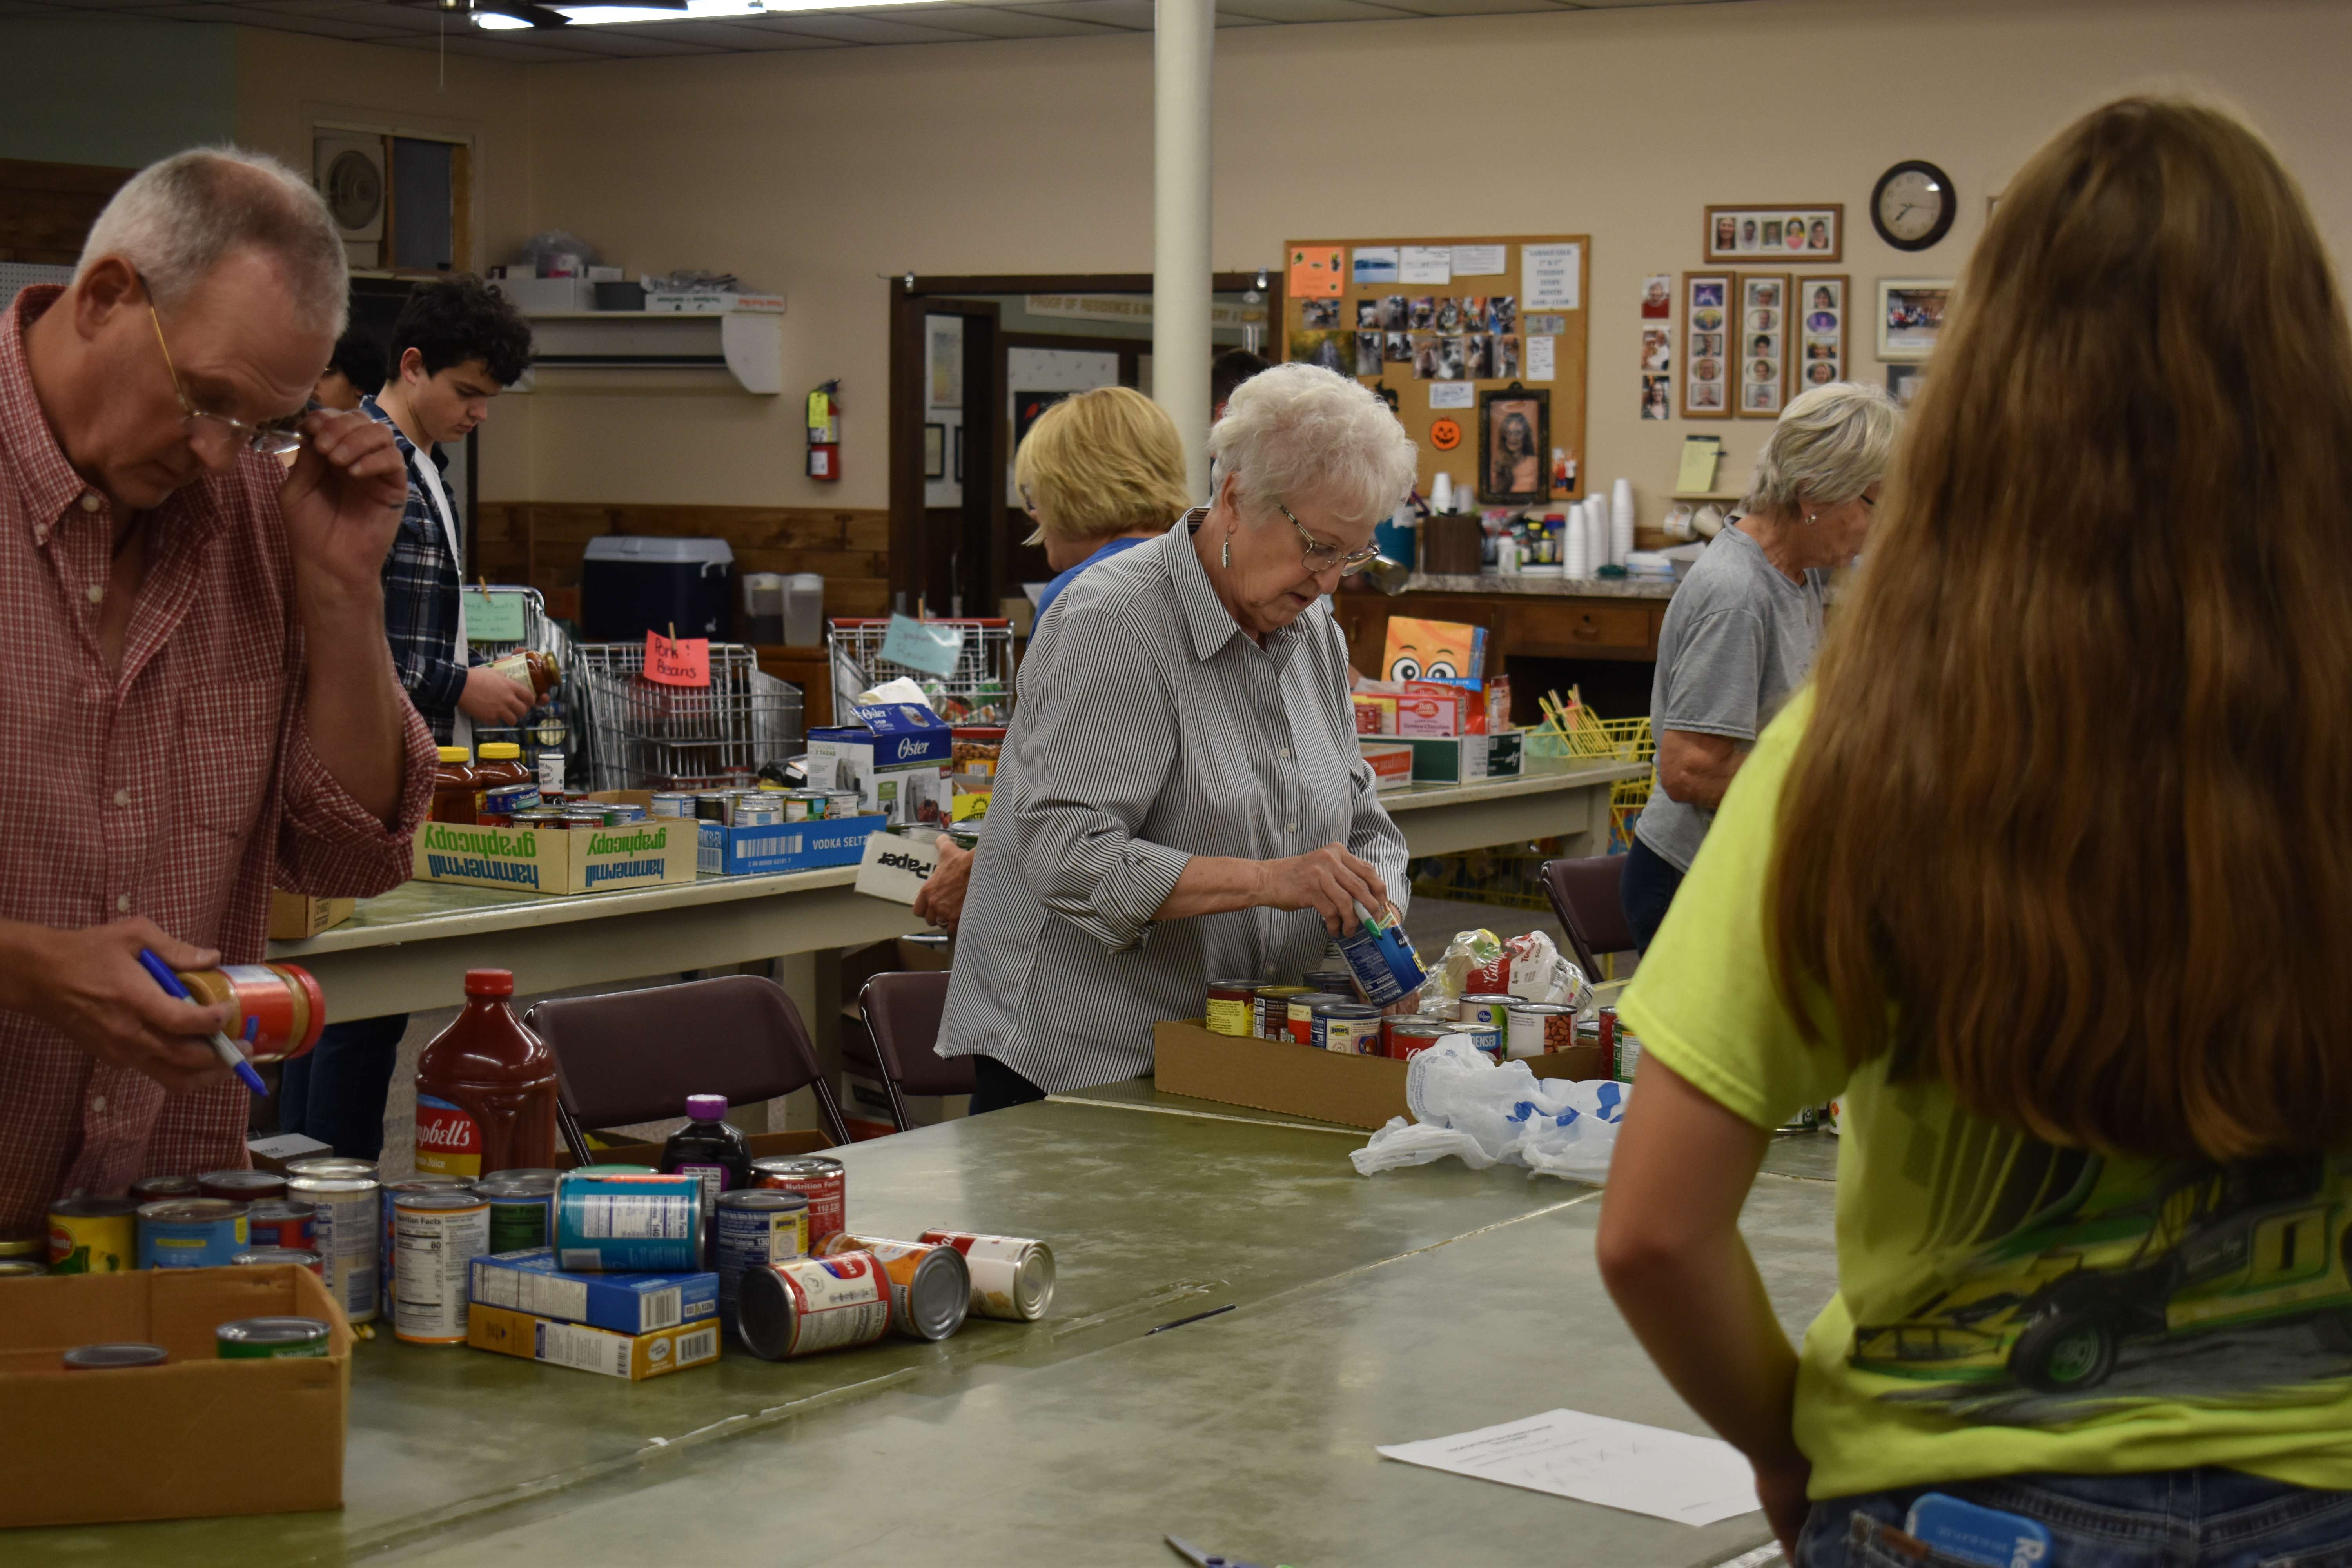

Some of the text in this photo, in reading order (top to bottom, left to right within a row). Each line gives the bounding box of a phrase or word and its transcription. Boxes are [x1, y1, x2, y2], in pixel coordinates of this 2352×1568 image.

[655, 637, 679, 659] Pork
[657, 659, 697, 678] Beans
[862, 708, 886, 720] Oster
[898, 738, 929, 759] Oster
[425, 825, 536, 859] graphicopy
[587, 827, 666, 857] graphicopy
[813, 838, 841, 850] VODKA
[428, 854, 539, 889] hammermill
[586, 858, 665, 887] hammermill
[878, 852, 931, 879] Paper
[427, 1158, 445, 1168] Juice
[817, 1204, 829, 1212] 110
[757, 1238, 769, 1246] 130
